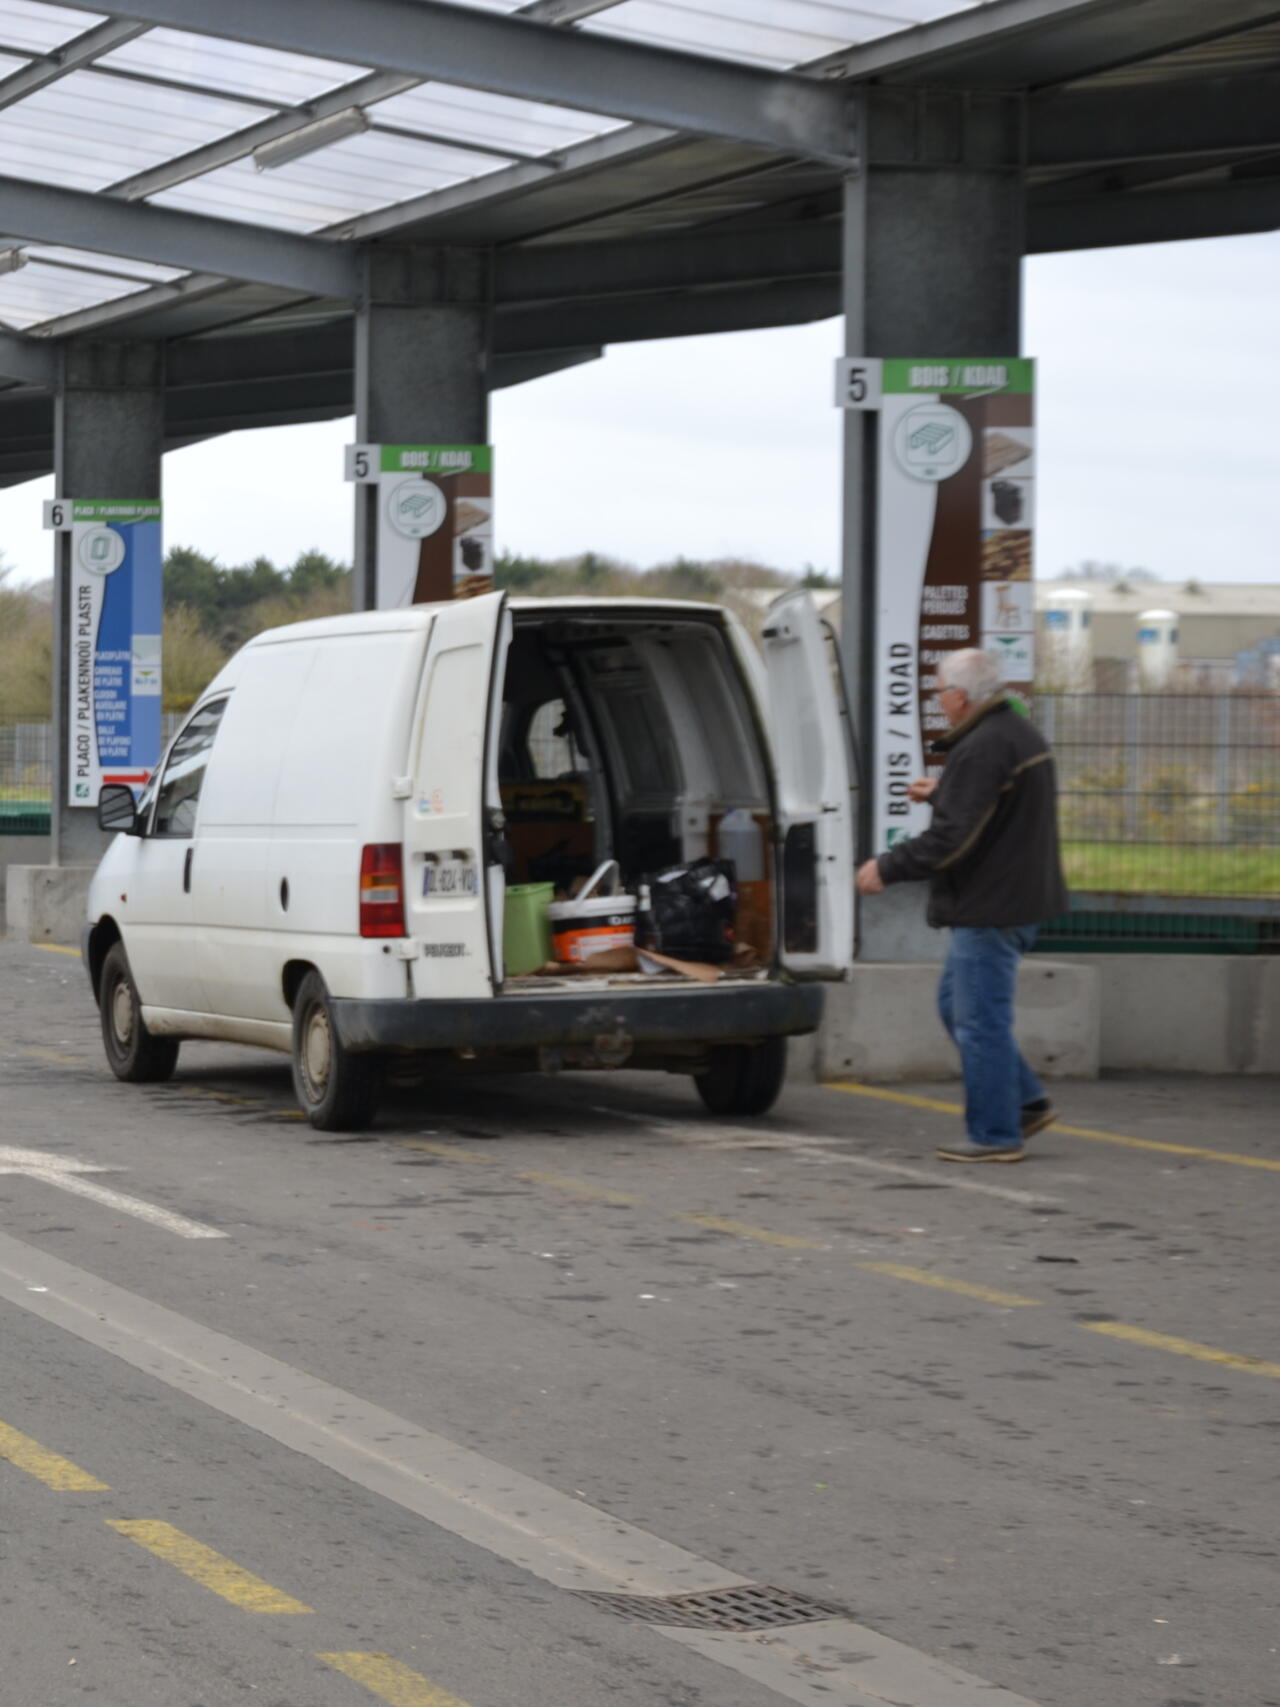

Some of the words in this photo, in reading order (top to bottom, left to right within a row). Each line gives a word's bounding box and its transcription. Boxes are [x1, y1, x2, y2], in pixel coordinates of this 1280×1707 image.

[849, 367, 867, 402] 5
[910, 366, 950, 387] BOIS
[354, 452, 369, 478] 5
[51, 505, 64, 527] 6
[78, 585, 92, 636] PLASTR
[75, 643, 91, 720] PLAKENNOÙ
[889, 643, 913, 715] KOAD
[77, 733, 90, 777] PLACO
[888, 753, 910, 816] BOIS
